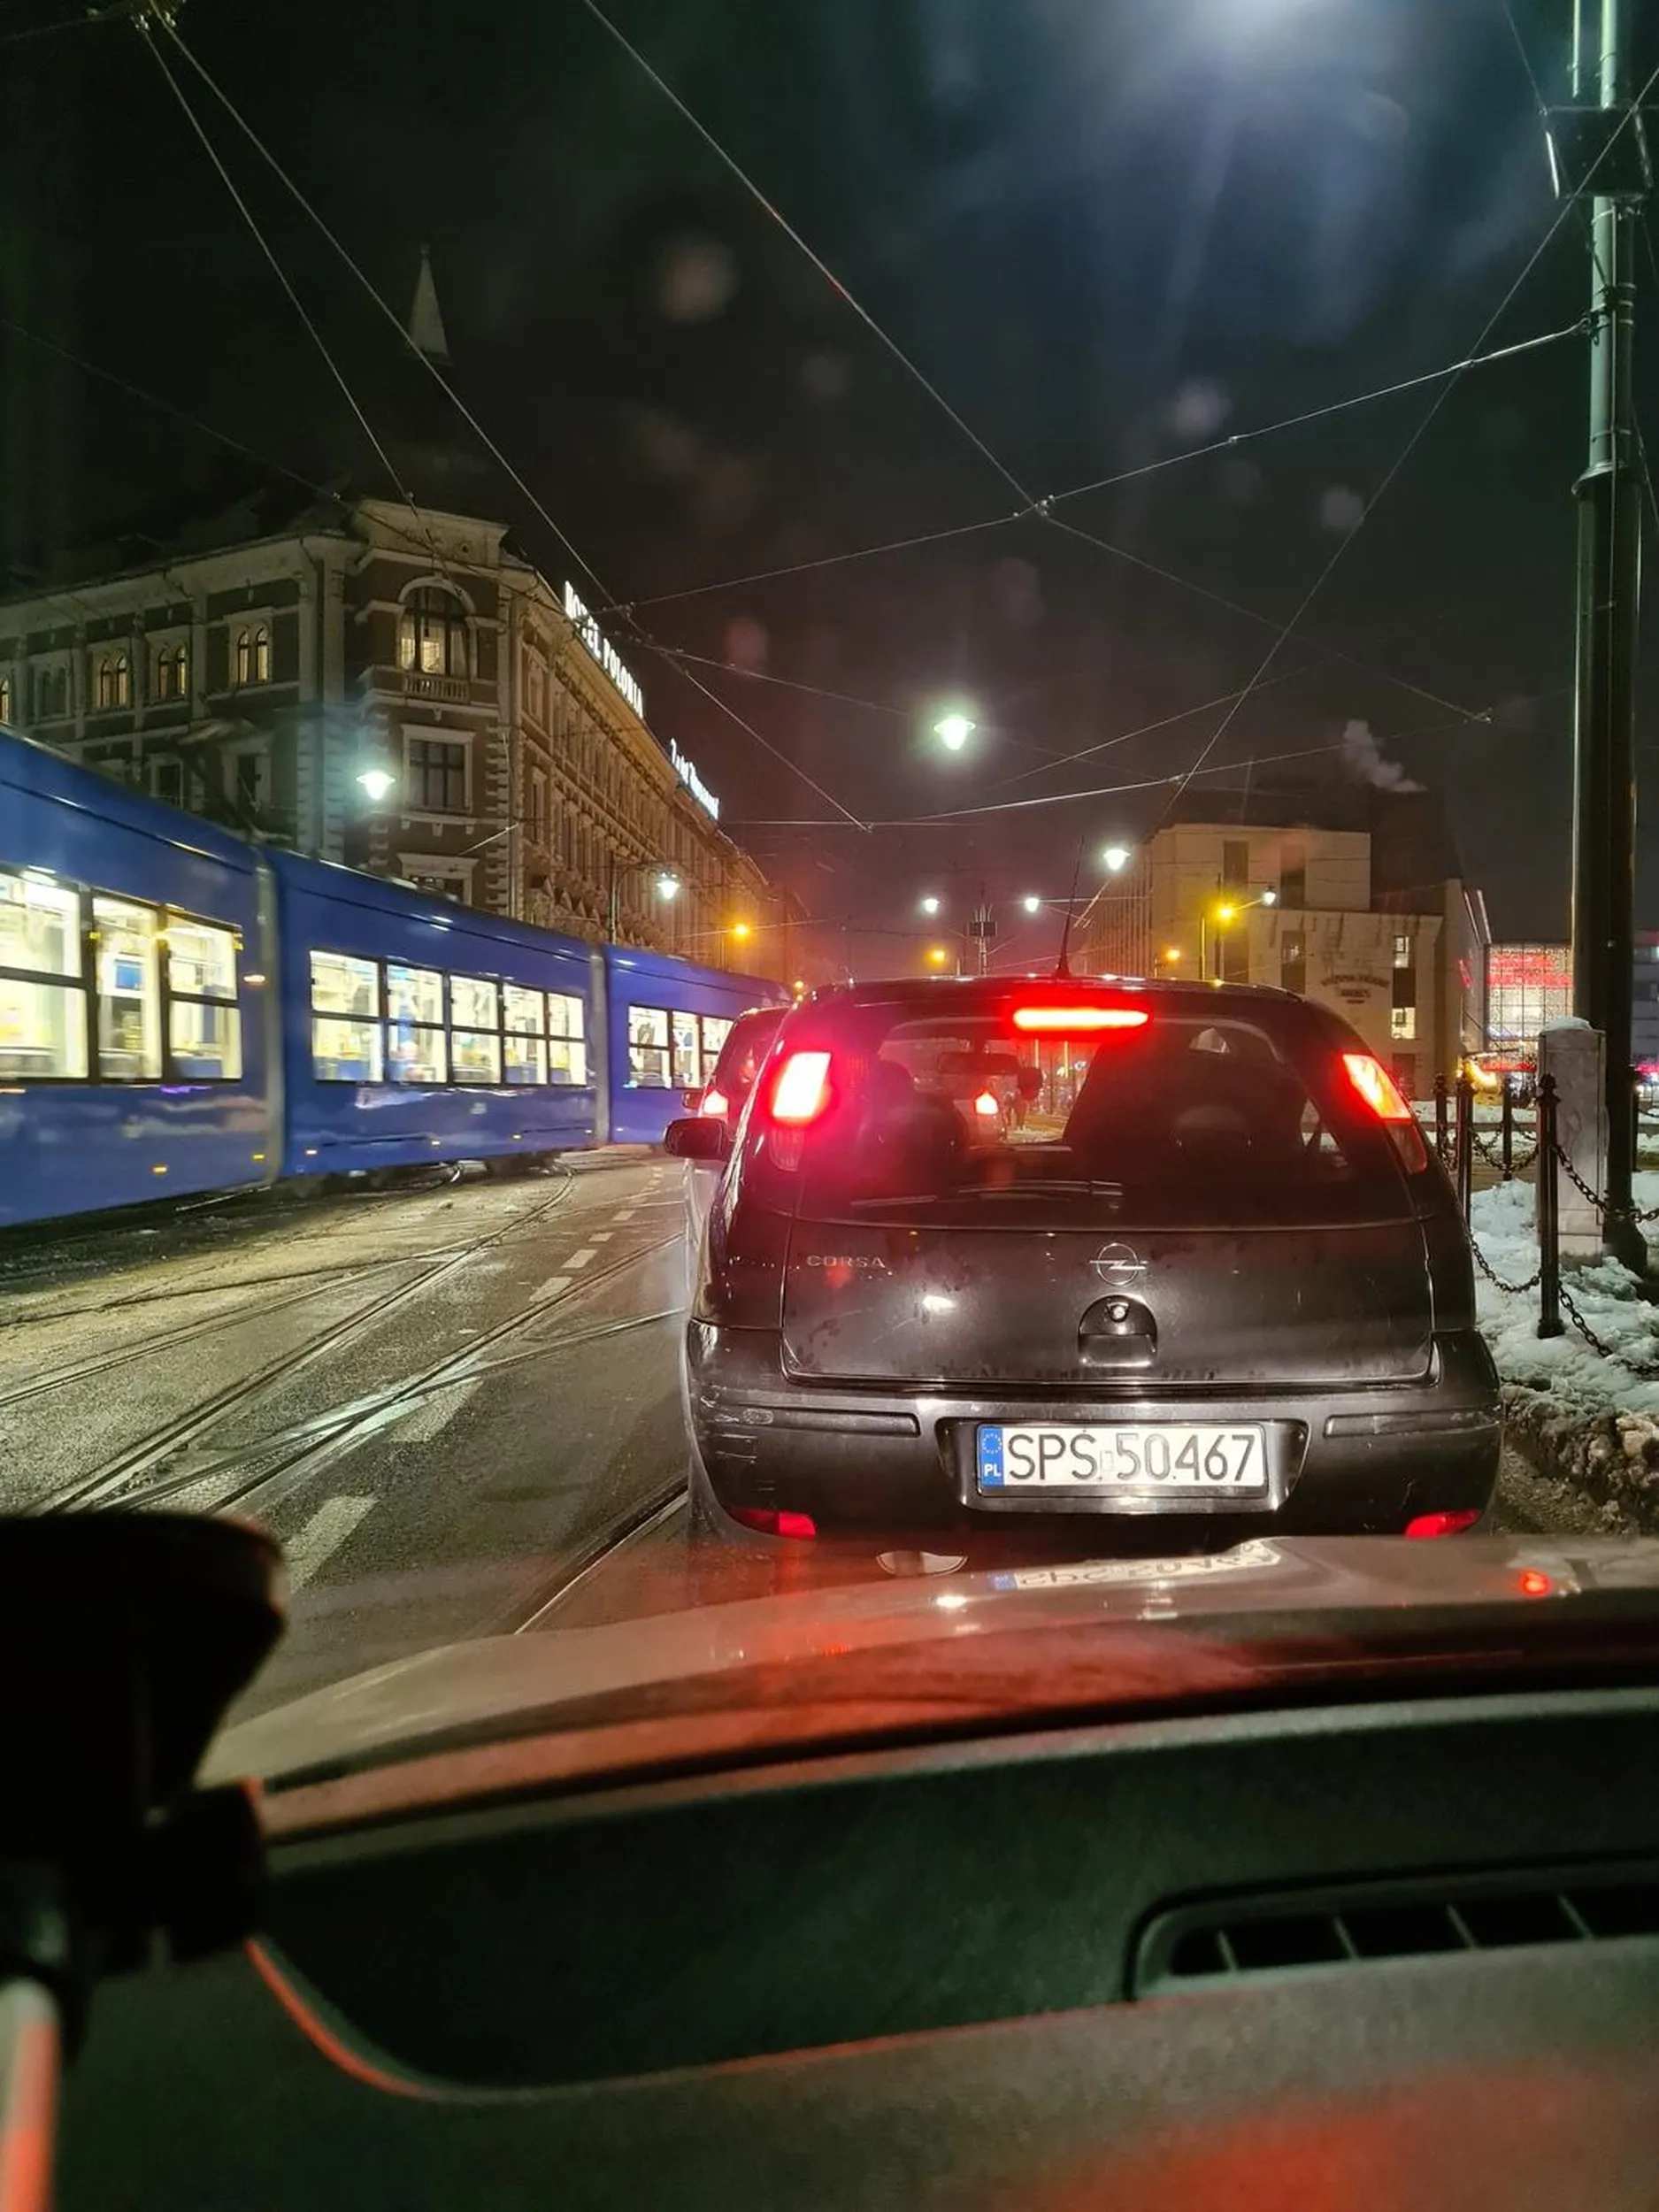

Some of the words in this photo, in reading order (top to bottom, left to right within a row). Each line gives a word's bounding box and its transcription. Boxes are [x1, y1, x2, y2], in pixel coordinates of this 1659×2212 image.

[807, 1255, 886, 1268] CORSA
[1008, 1433, 1098, 1480] SPS
[1116, 1433, 1256, 1481] 50467
[984, 1463, 1002, 1478] PL
